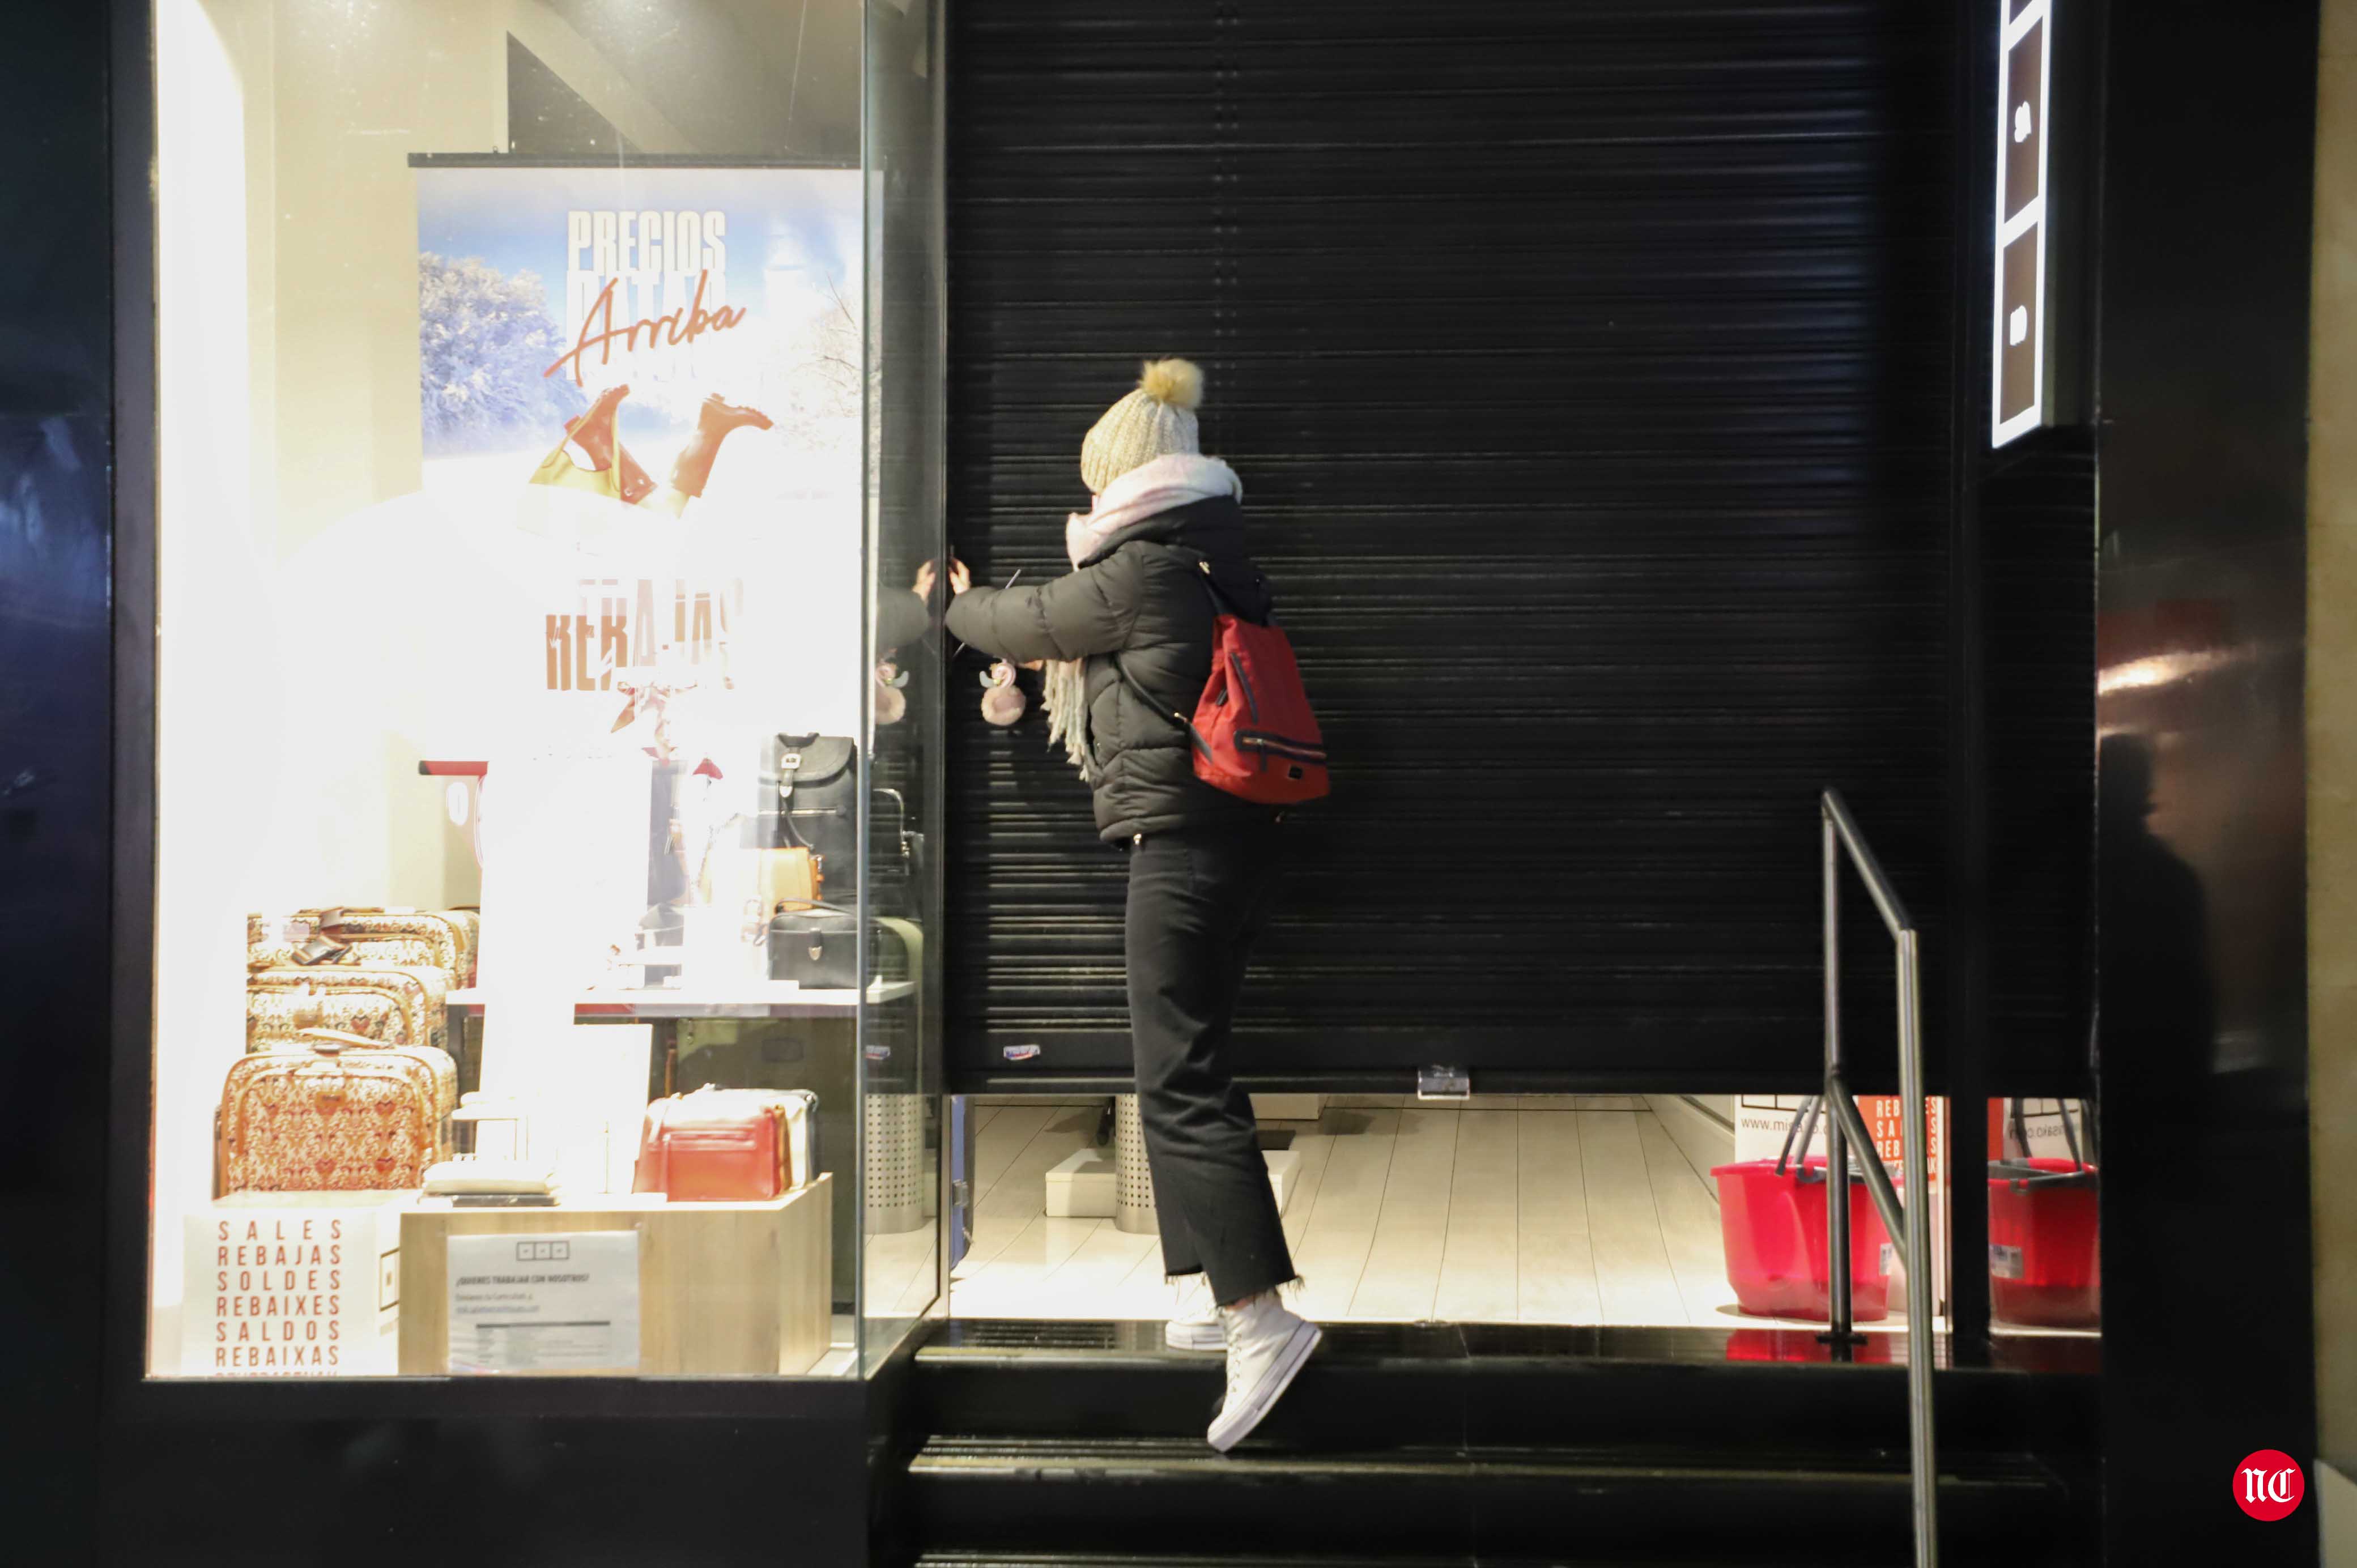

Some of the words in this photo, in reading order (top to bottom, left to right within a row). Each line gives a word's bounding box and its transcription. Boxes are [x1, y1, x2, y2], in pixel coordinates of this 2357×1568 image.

[568, 211, 726, 273] PRECIOS
[543, 269, 746, 387] Arriba
[218, 1220, 341, 1241] SALES
[218, 1245, 341, 1266] REBAJAS
[217, 1270, 341, 1291] SOLDES
[216, 1295, 339, 1316] REBAIXES
[216, 1320, 339, 1342] SALDOS
[215, 1346, 339, 1367] REBAIXAS
